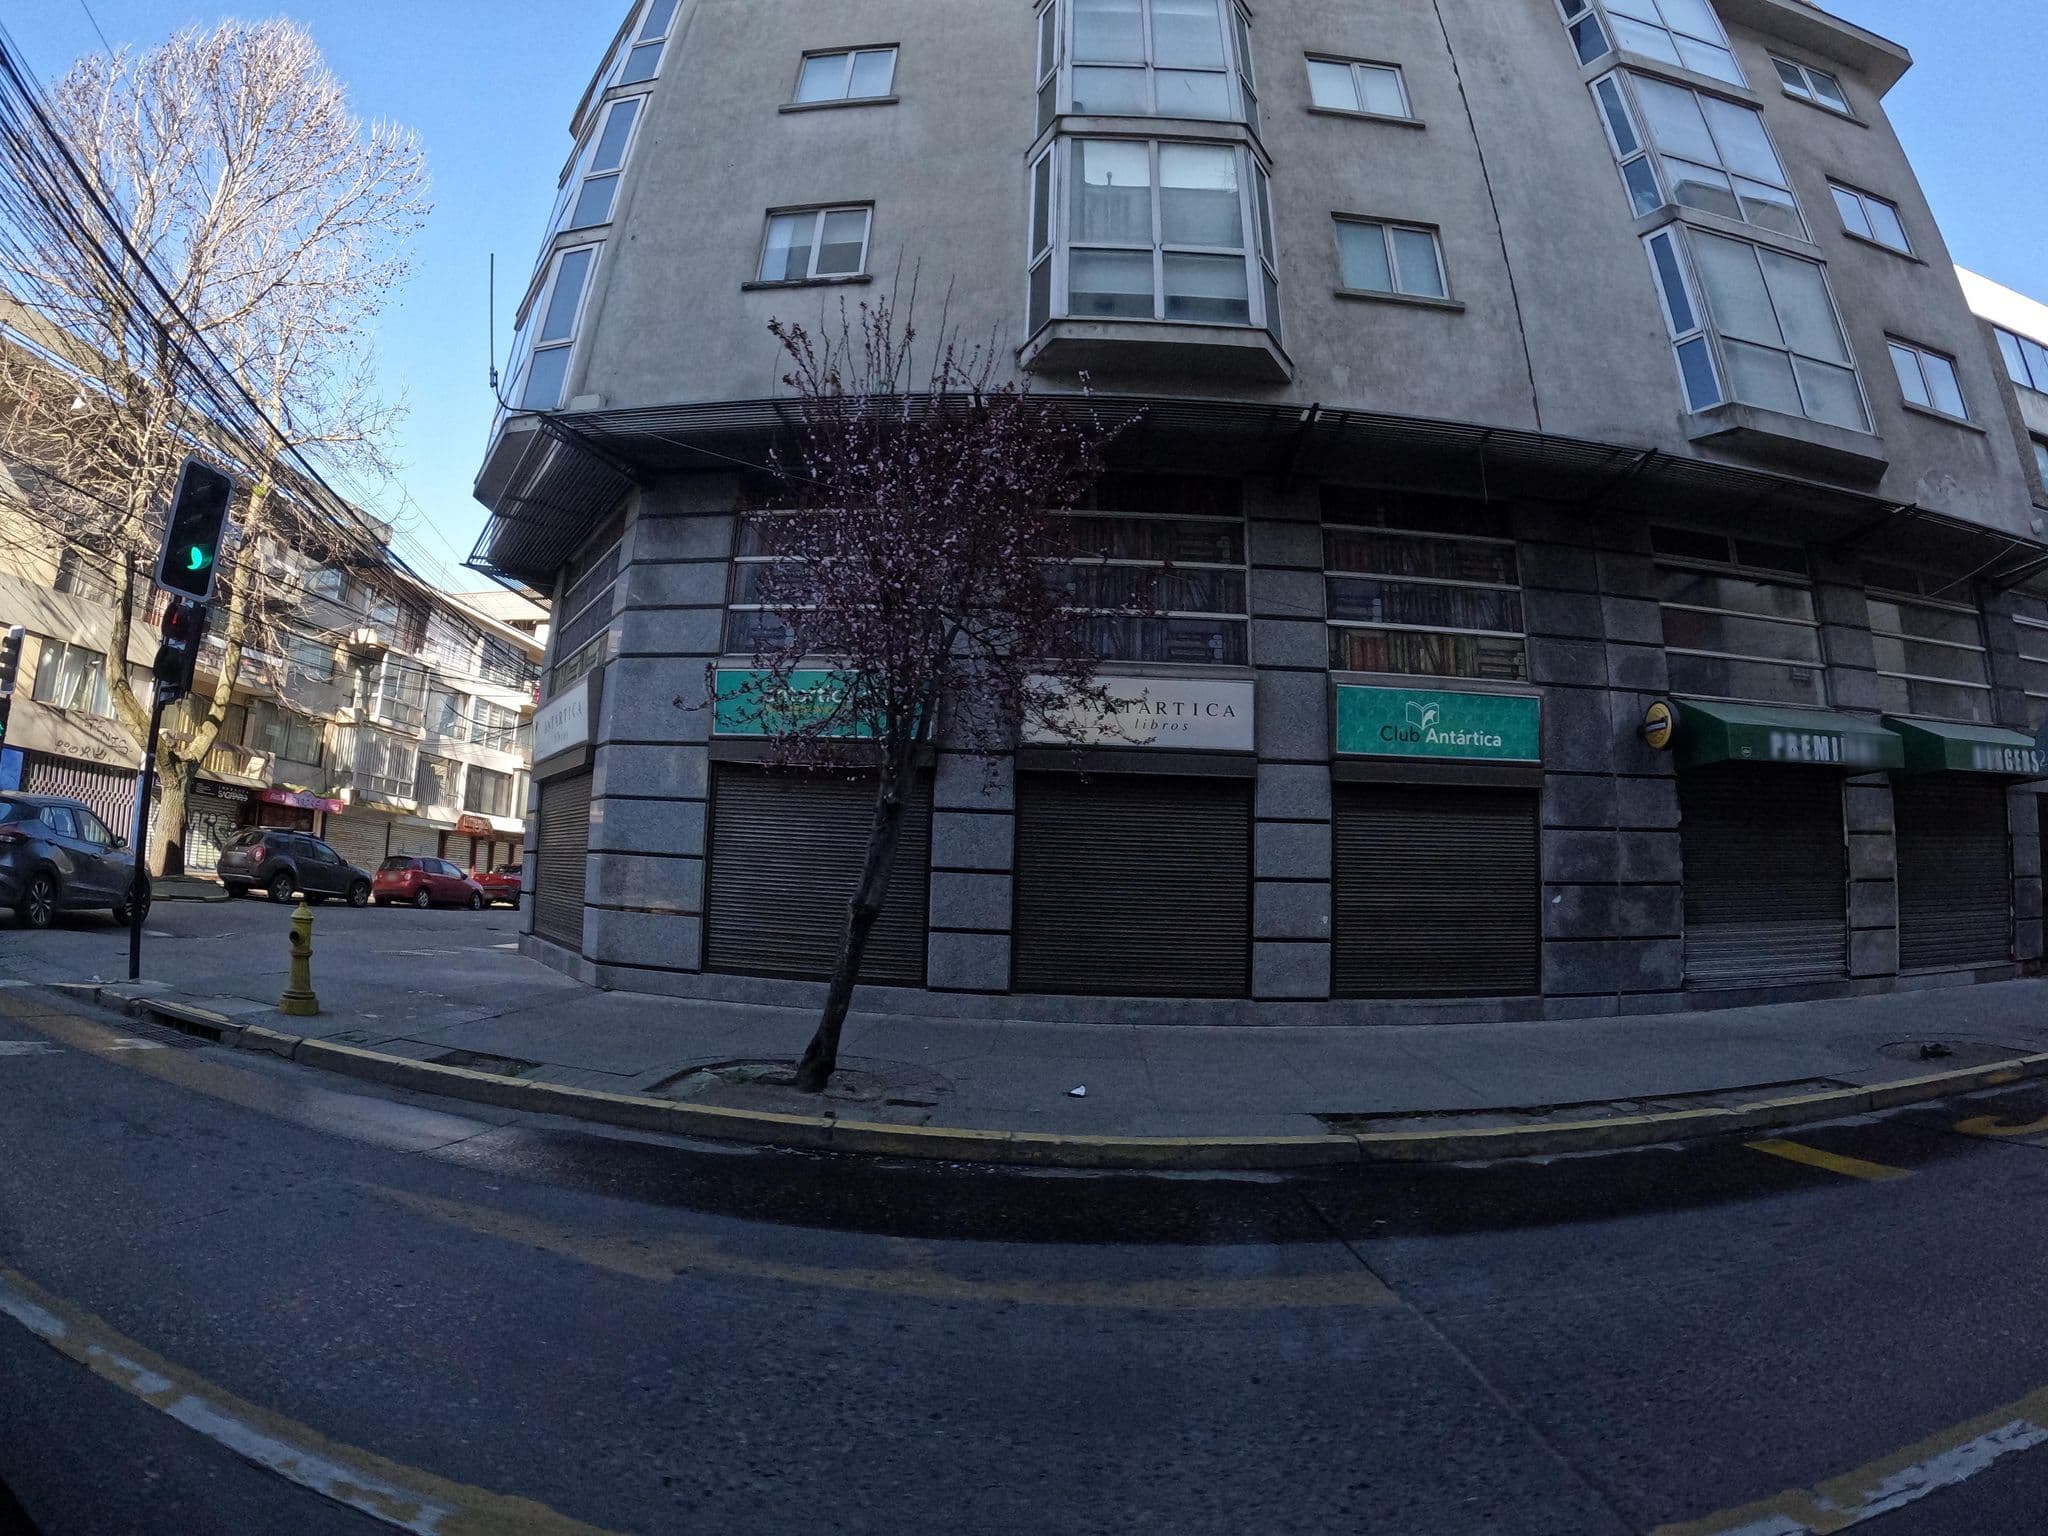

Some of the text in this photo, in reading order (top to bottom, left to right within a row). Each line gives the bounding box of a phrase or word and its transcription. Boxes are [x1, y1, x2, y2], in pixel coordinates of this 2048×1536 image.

[1087, 700, 1237, 718] ATARTICA
[1134, 718, 1190, 731] libros
[1380, 725, 1502, 747] Club Antártica
[1972, 746, 2040, 773] GERS
